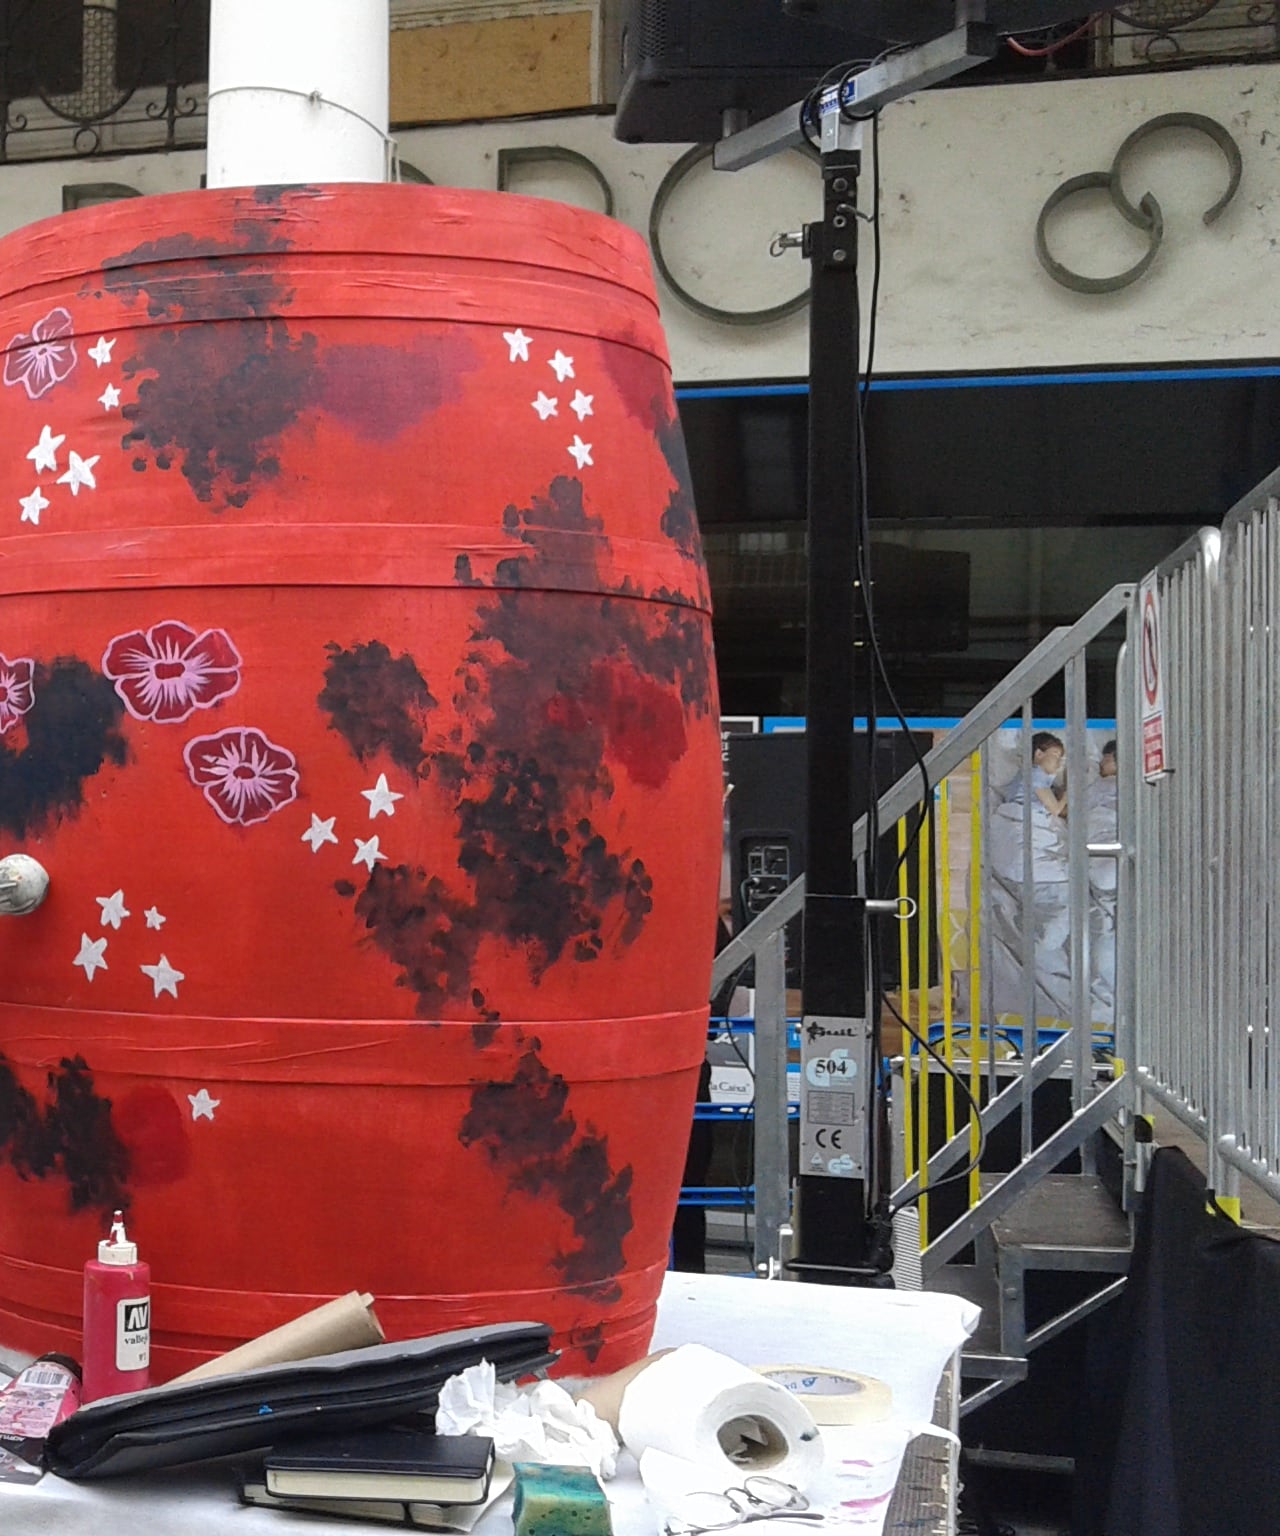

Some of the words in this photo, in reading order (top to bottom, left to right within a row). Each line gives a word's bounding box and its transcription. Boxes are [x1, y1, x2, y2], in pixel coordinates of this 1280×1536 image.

[815, 1059, 847, 1076] 504
[815, 1128, 842, 1150] CE
[128, 1305, 148, 1330] AV
